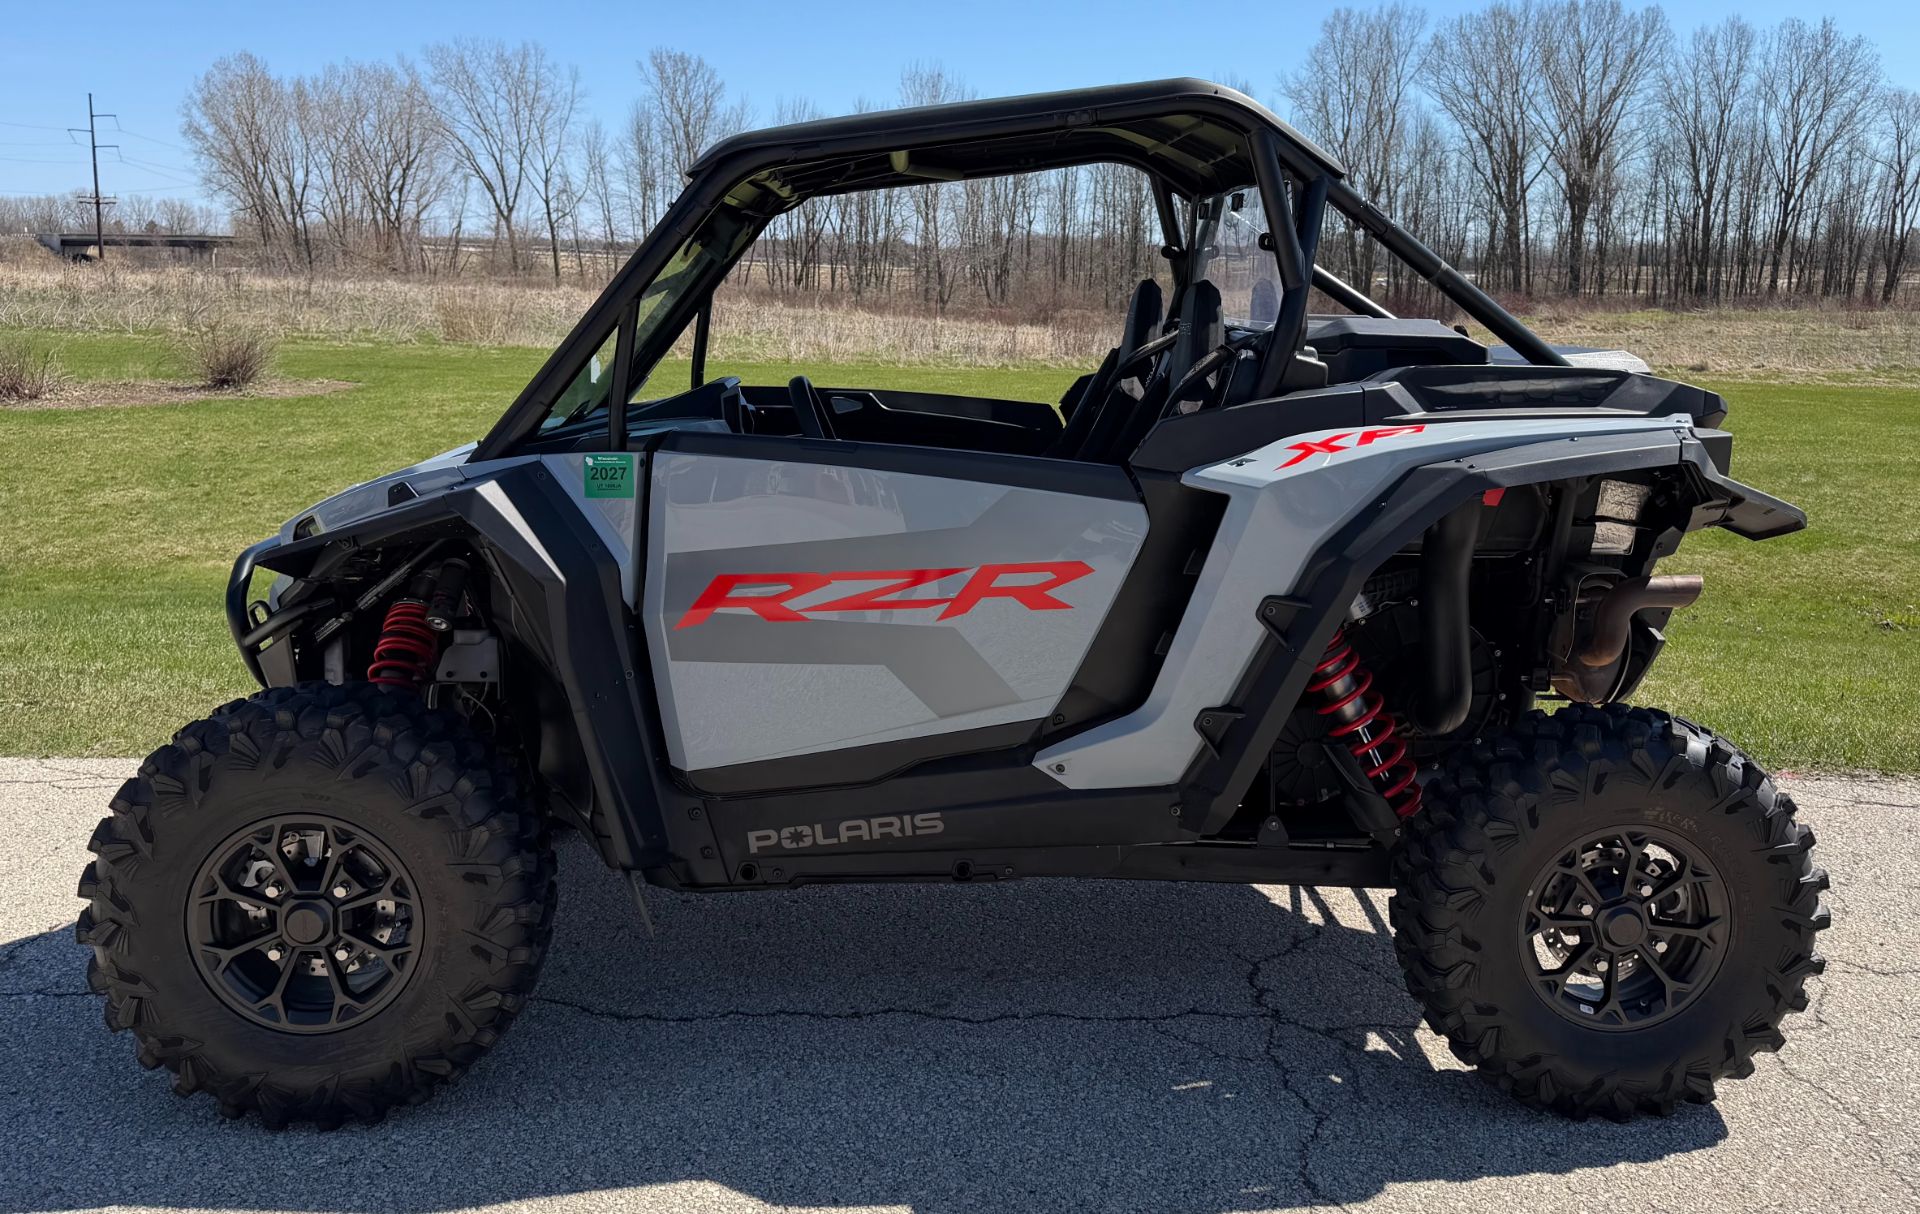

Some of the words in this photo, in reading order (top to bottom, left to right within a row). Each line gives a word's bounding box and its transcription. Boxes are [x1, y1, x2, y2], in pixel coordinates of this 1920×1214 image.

[1273, 424, 1426, 471] XP
[590, 467, 627, 480] 2027
[673, 560, 1096, 631] RZR
[747, 812, 945, 854] POLARIS
